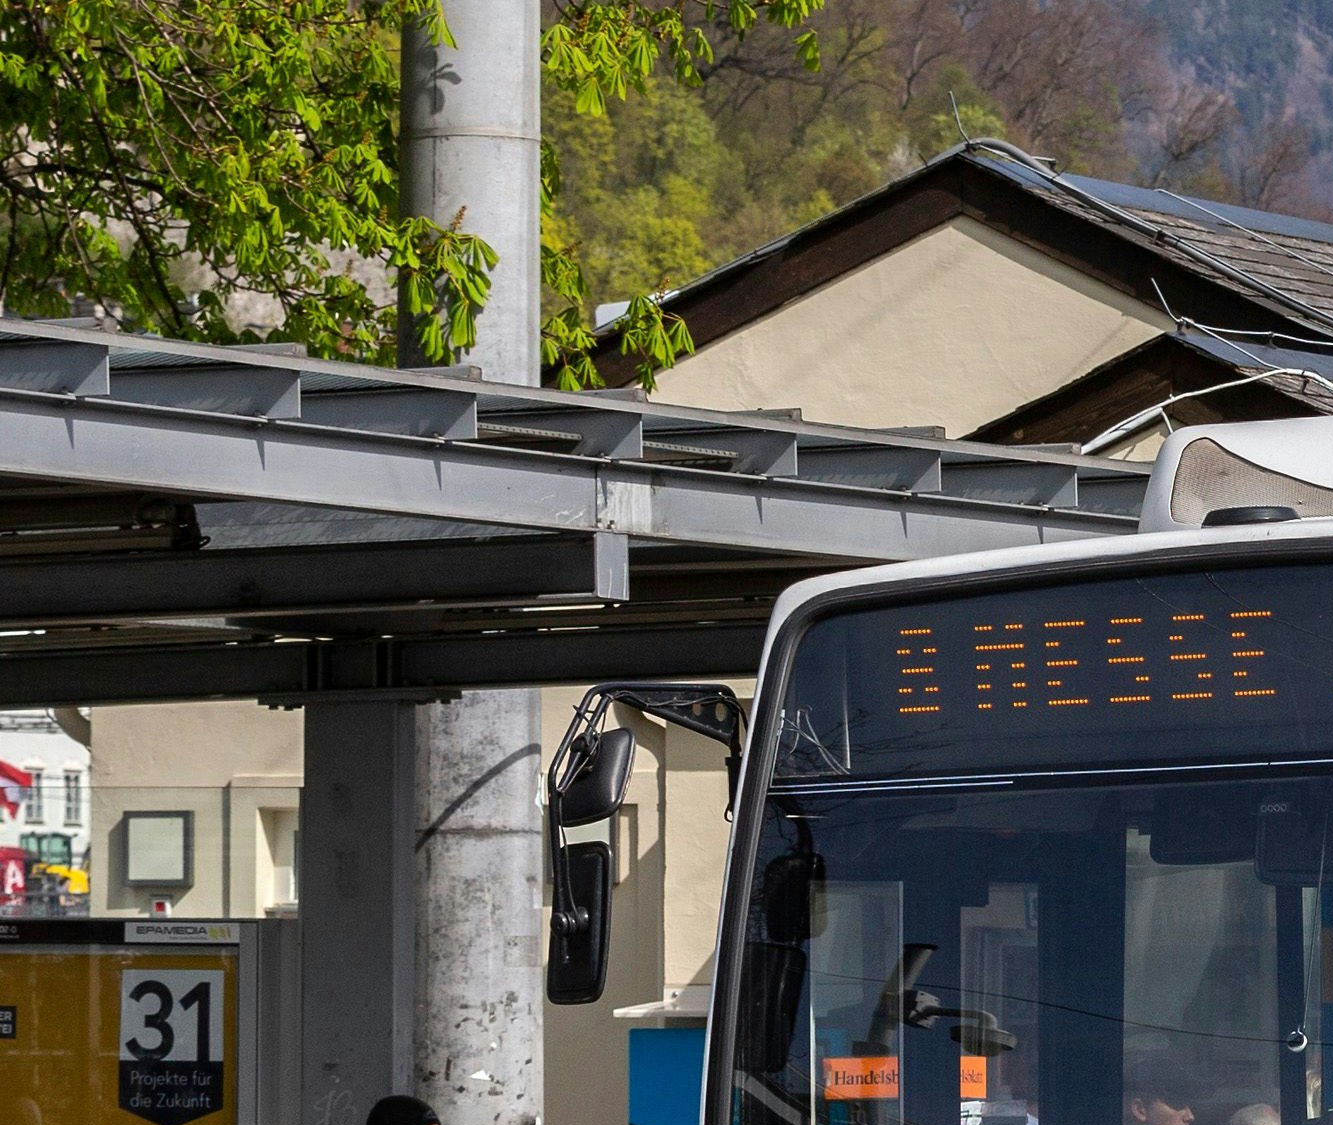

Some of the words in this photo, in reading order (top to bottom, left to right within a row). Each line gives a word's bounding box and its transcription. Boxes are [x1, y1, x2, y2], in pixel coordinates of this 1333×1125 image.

[973, 612, 1276, 710] MESSE
[136, 926, 207, 936] EPAMEDIA
[125, 980, 211, 1065] 31
[130, 1070, 188, 1090] Projekte
[192, 1070, 212, 1086] für
[130, 1092, 152, 1108] die
[156, 1092, 211, 1109] Zukunft
